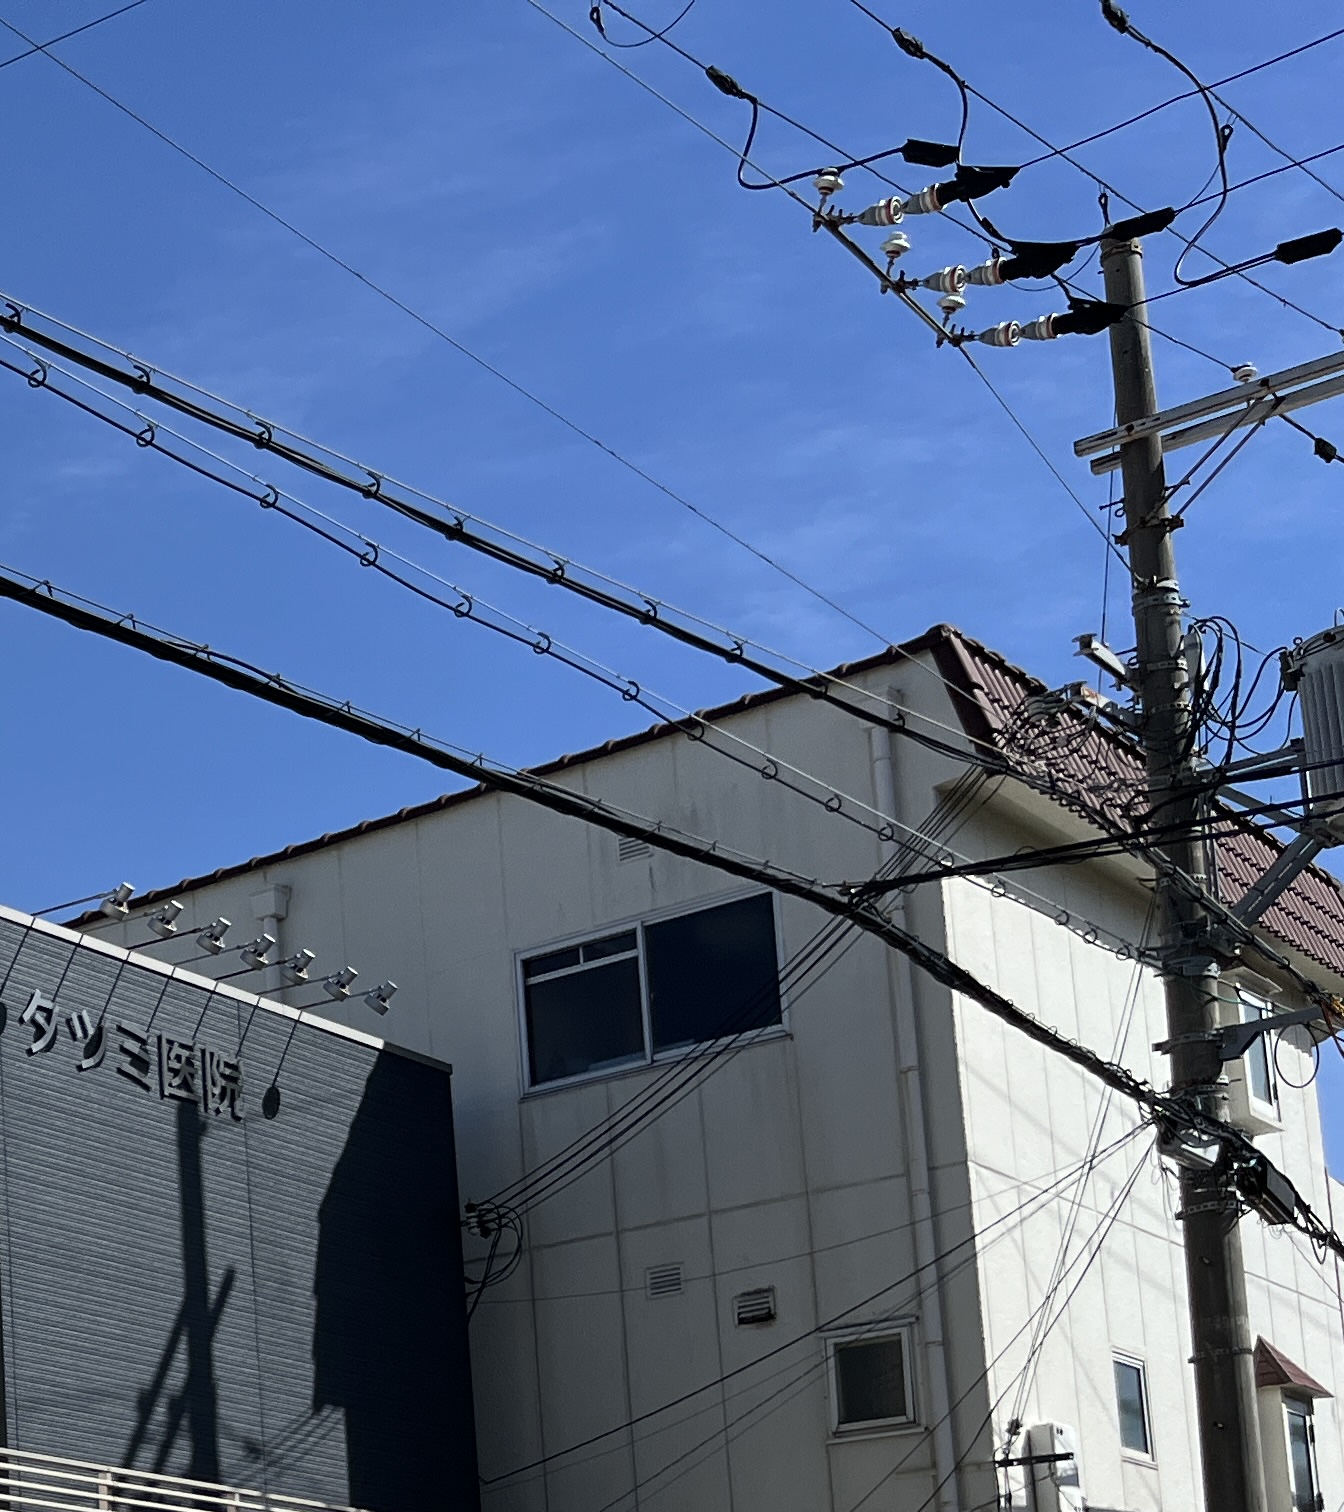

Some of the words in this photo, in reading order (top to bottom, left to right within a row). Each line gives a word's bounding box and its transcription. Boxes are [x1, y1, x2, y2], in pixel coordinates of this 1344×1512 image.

[21, 988, 246, 1121] タツミ医院
